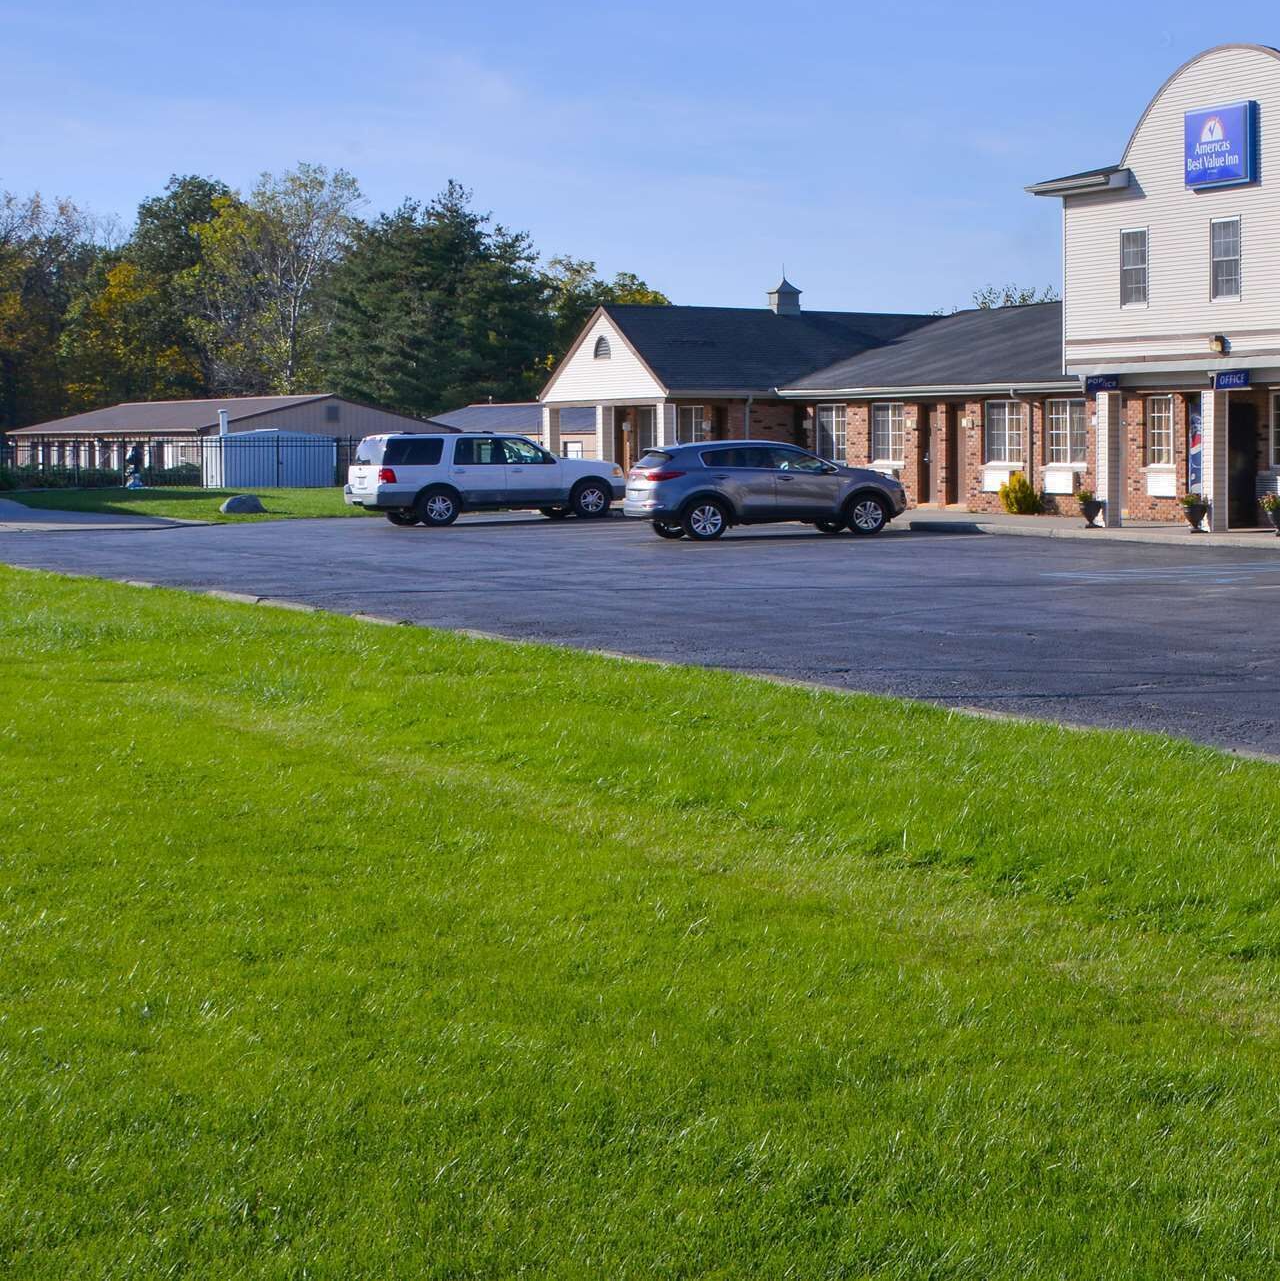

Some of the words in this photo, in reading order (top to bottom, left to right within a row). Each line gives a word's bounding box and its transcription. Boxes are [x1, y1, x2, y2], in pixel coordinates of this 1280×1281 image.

[1194, 141, 1231, 156] Americas
[1187, 158, 1203, 171] Best
[1203, 154, 1225, 169] Value
[1225, 153, 1239, 167] Inn
[1219, 373, 1245, 385] OFFICE
